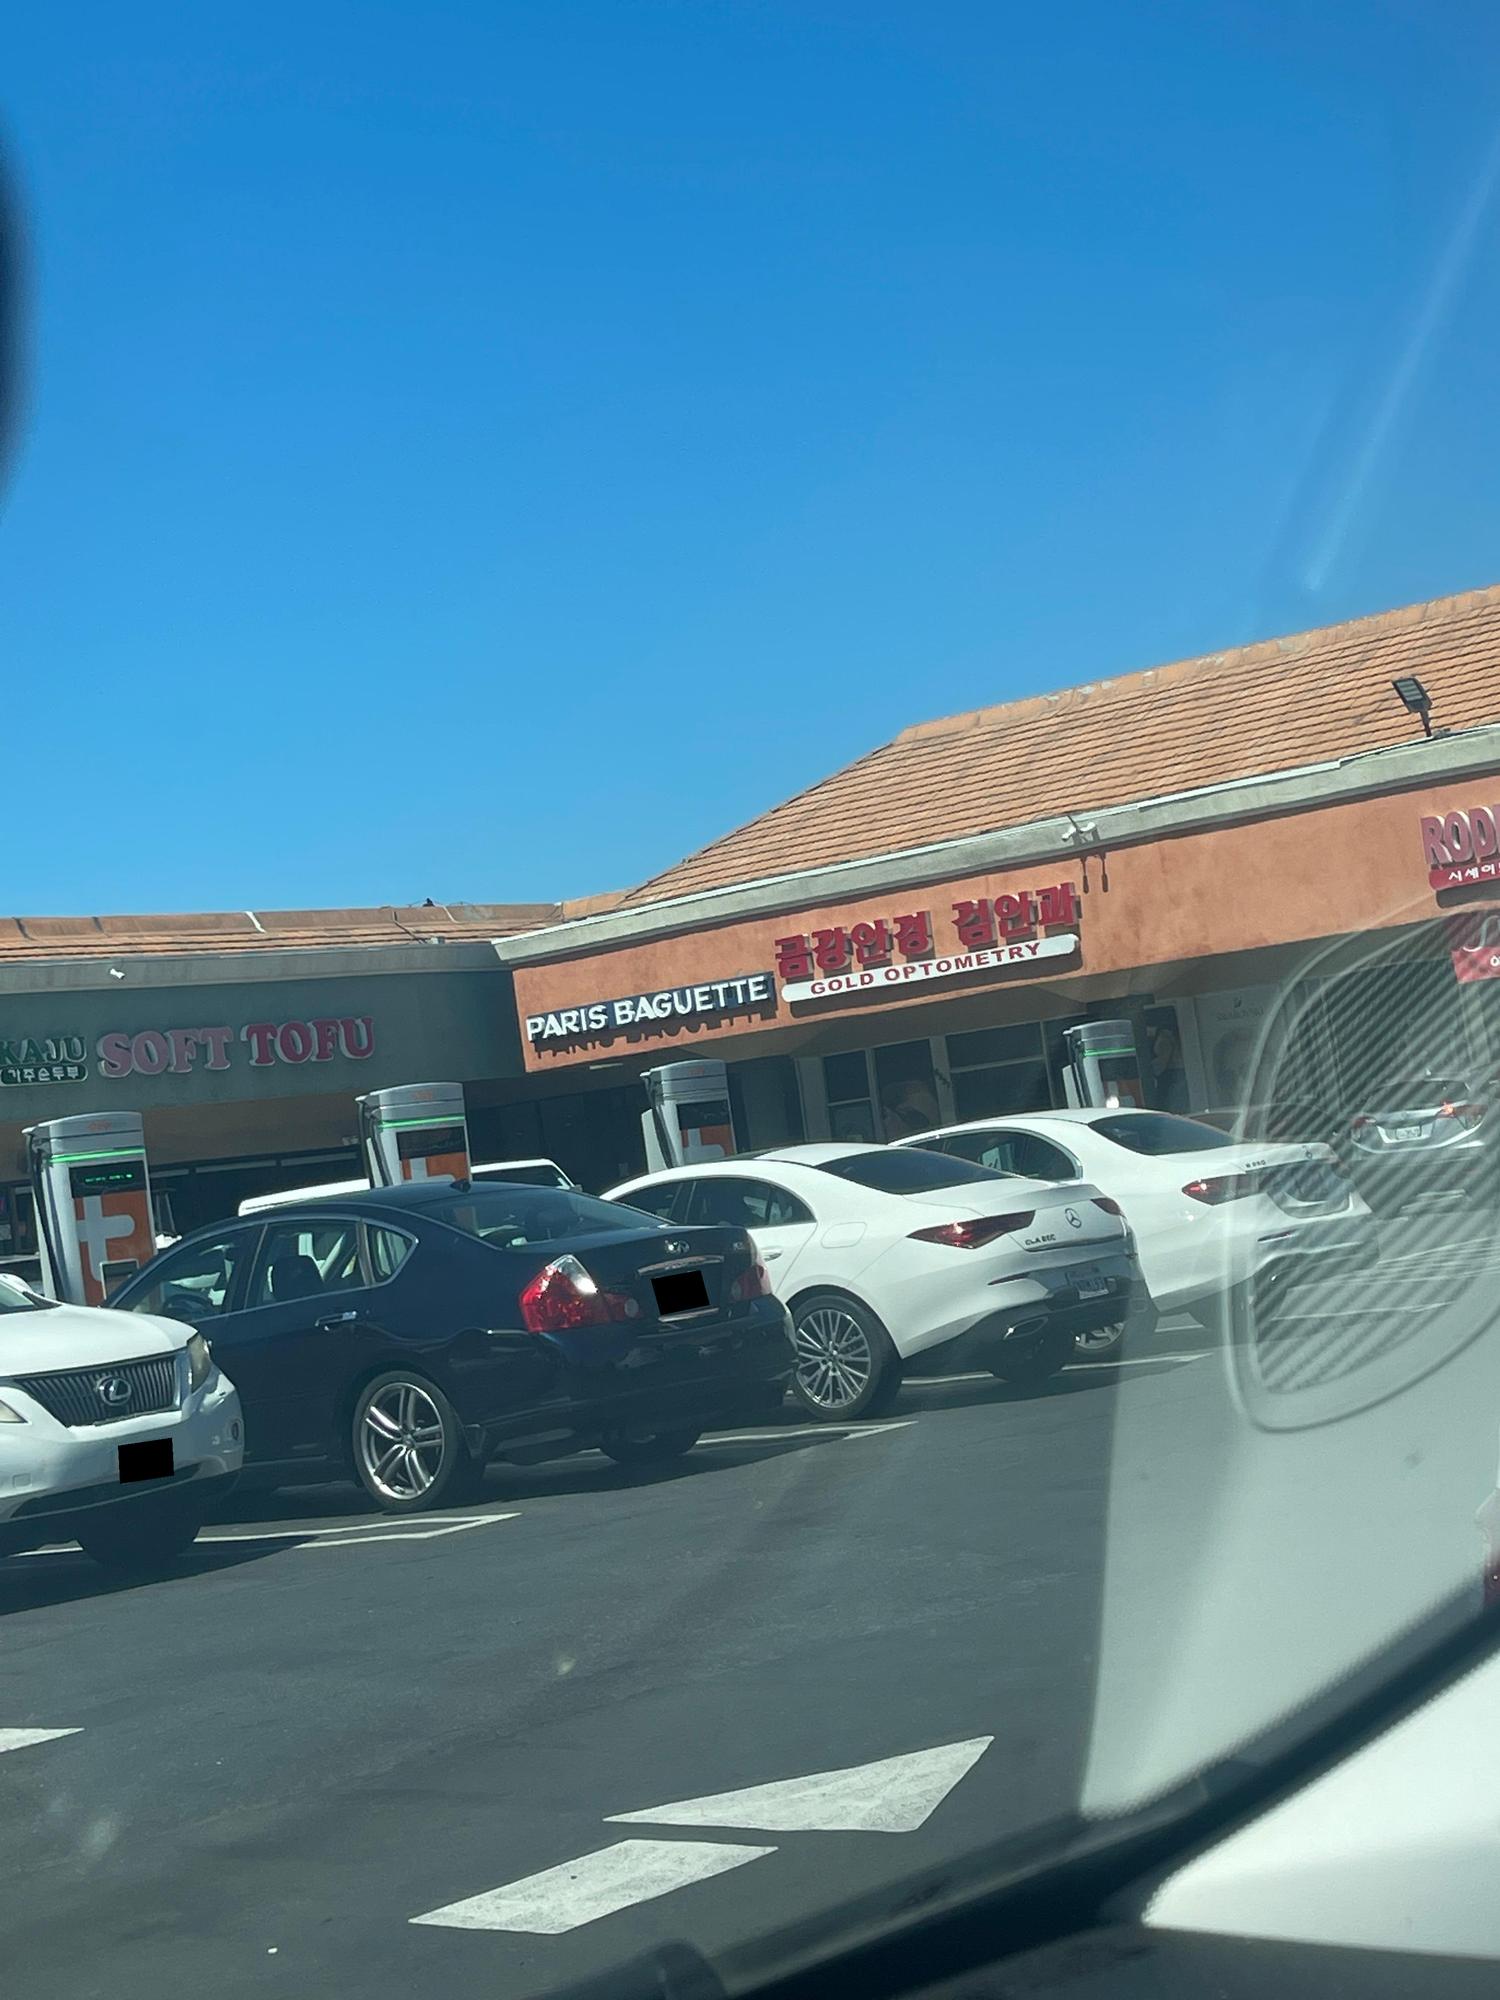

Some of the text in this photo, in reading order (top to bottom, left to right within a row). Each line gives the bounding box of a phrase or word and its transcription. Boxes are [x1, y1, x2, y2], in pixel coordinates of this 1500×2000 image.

[1420, 804, 1500, 866] ROD
[1448, 862, 1500, 883] 시세이
[774, 882, 1080, 979] 금강안경 검안과
[810, 942, 1041, 996] GOLD OPTOMETRY
[525, 975, 769, 1042] PARIS BAGUETTE
[97, 1016, 375, 1079] SOFT TOFU
